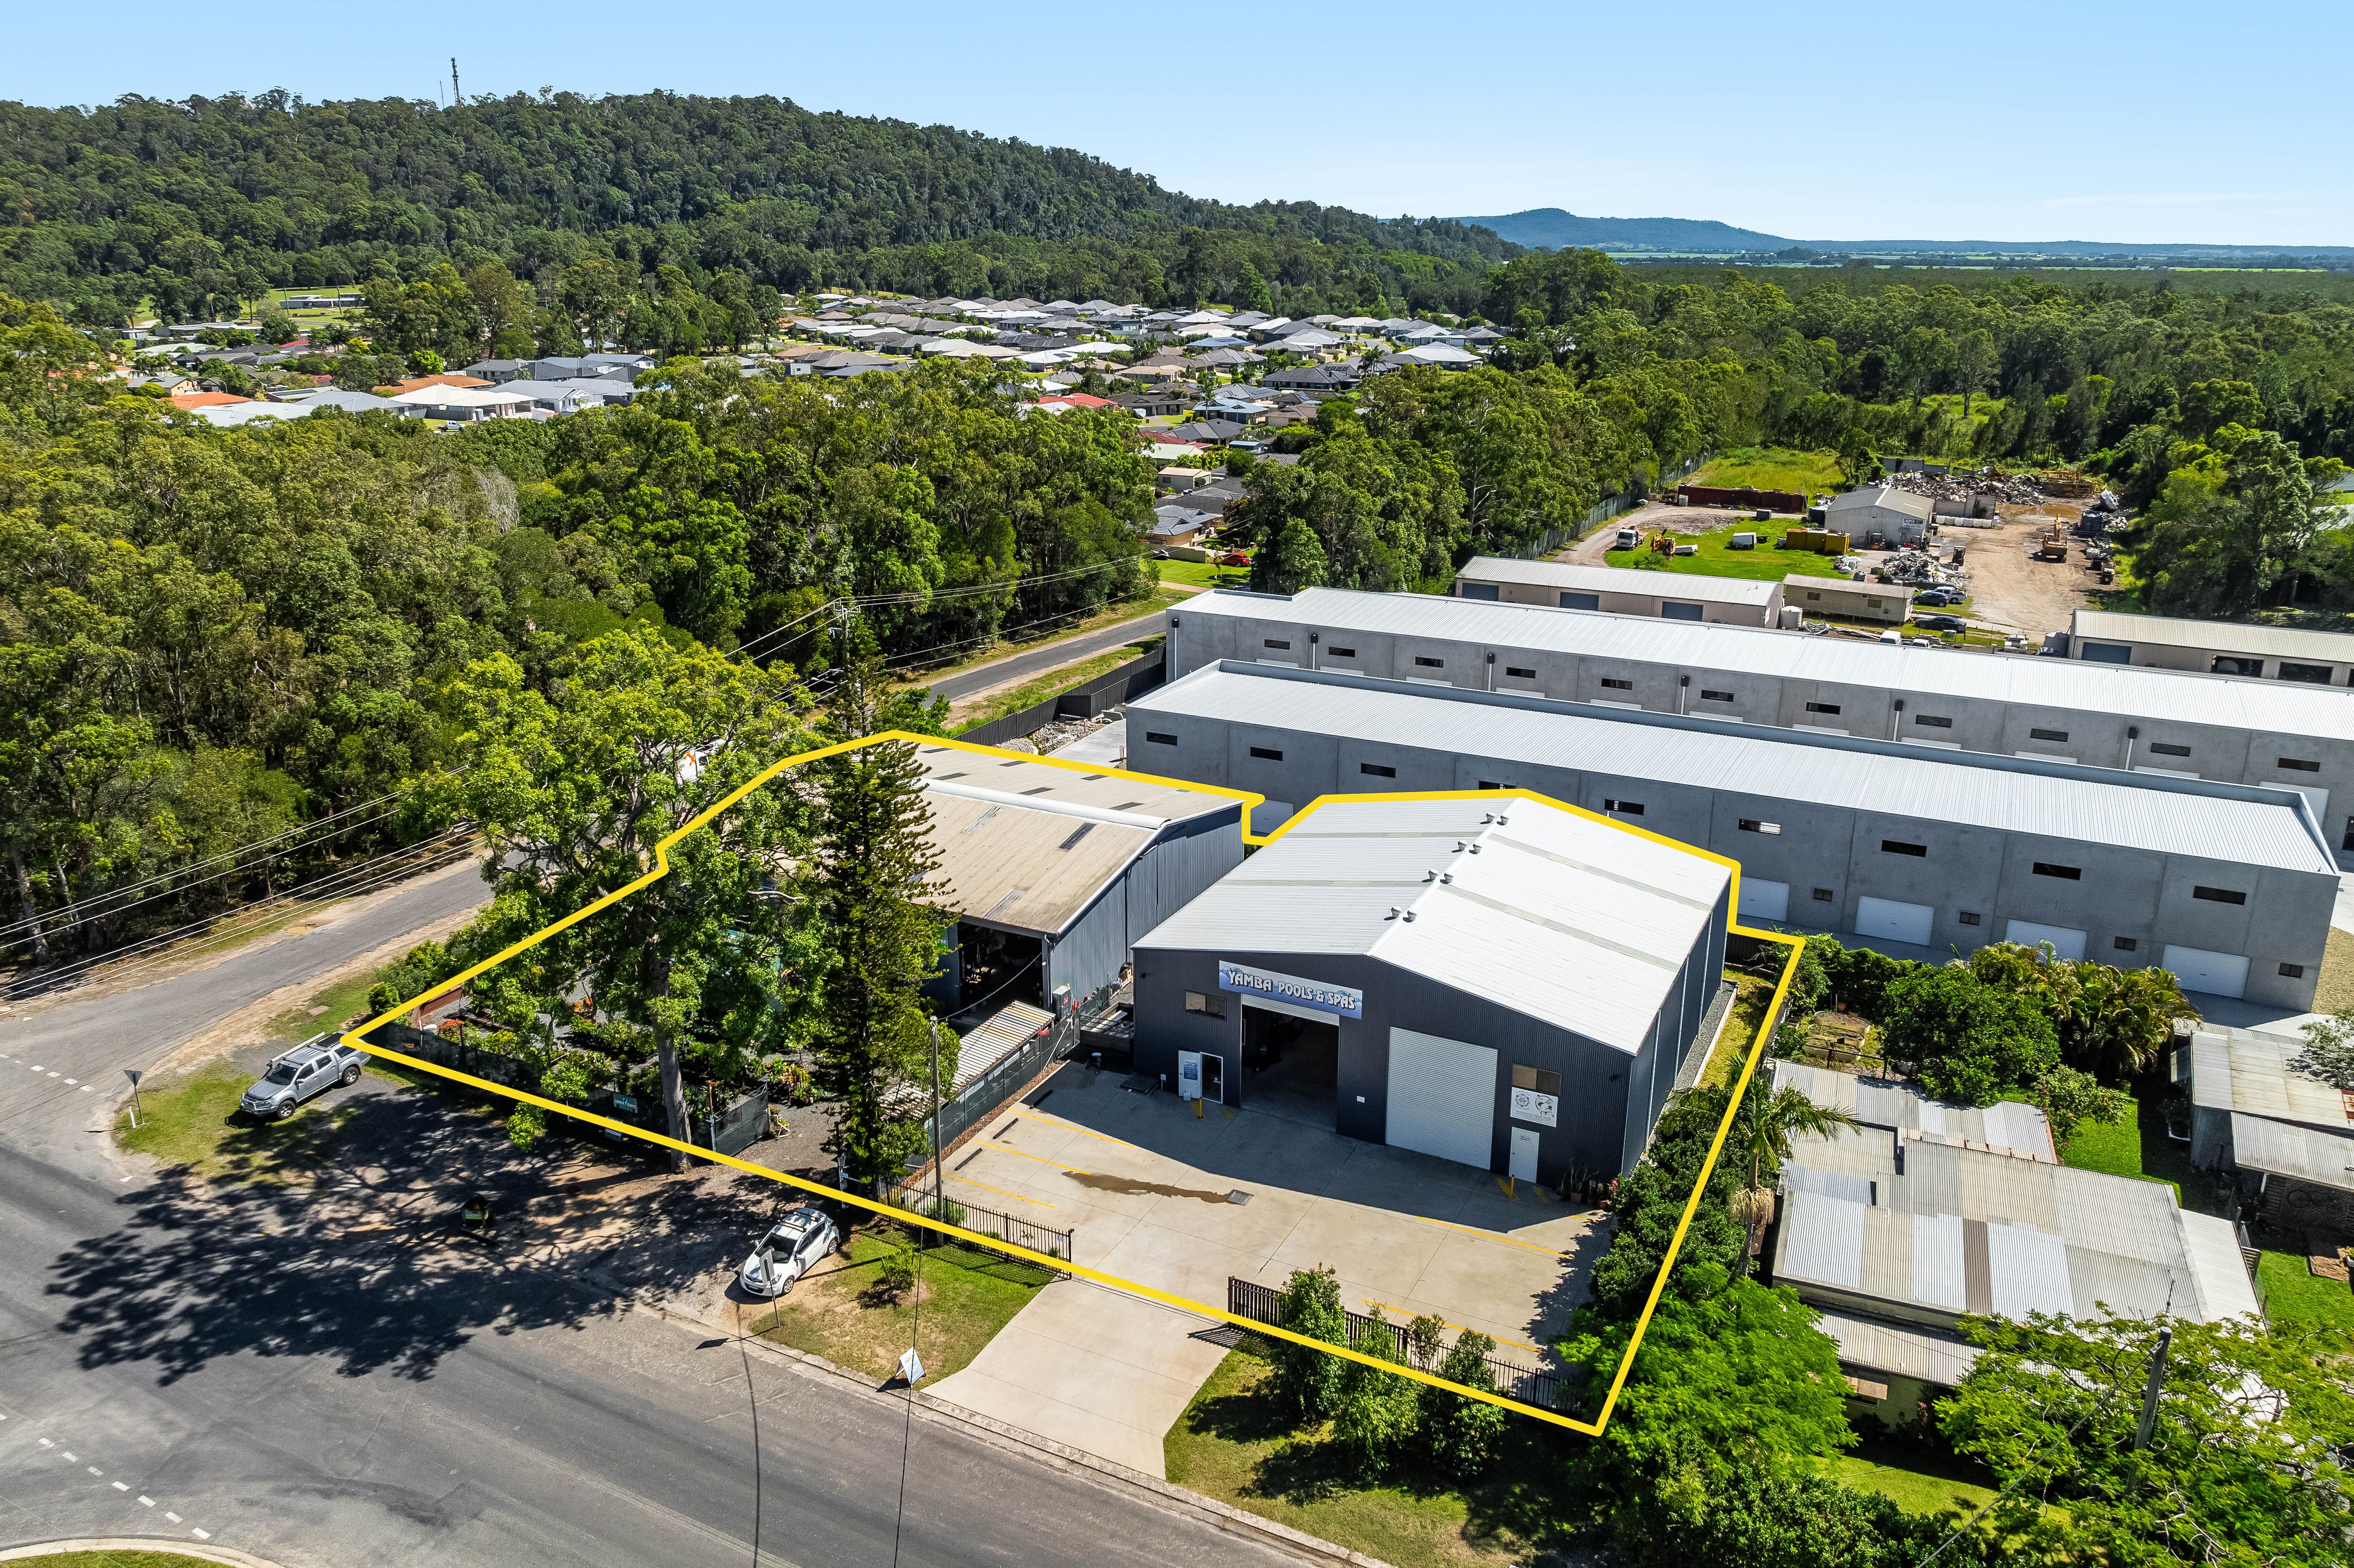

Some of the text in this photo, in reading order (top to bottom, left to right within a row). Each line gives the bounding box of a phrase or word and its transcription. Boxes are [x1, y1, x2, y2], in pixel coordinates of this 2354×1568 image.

[1228, 970, 1356, 1010] YAMBA POOLS & SPAS
